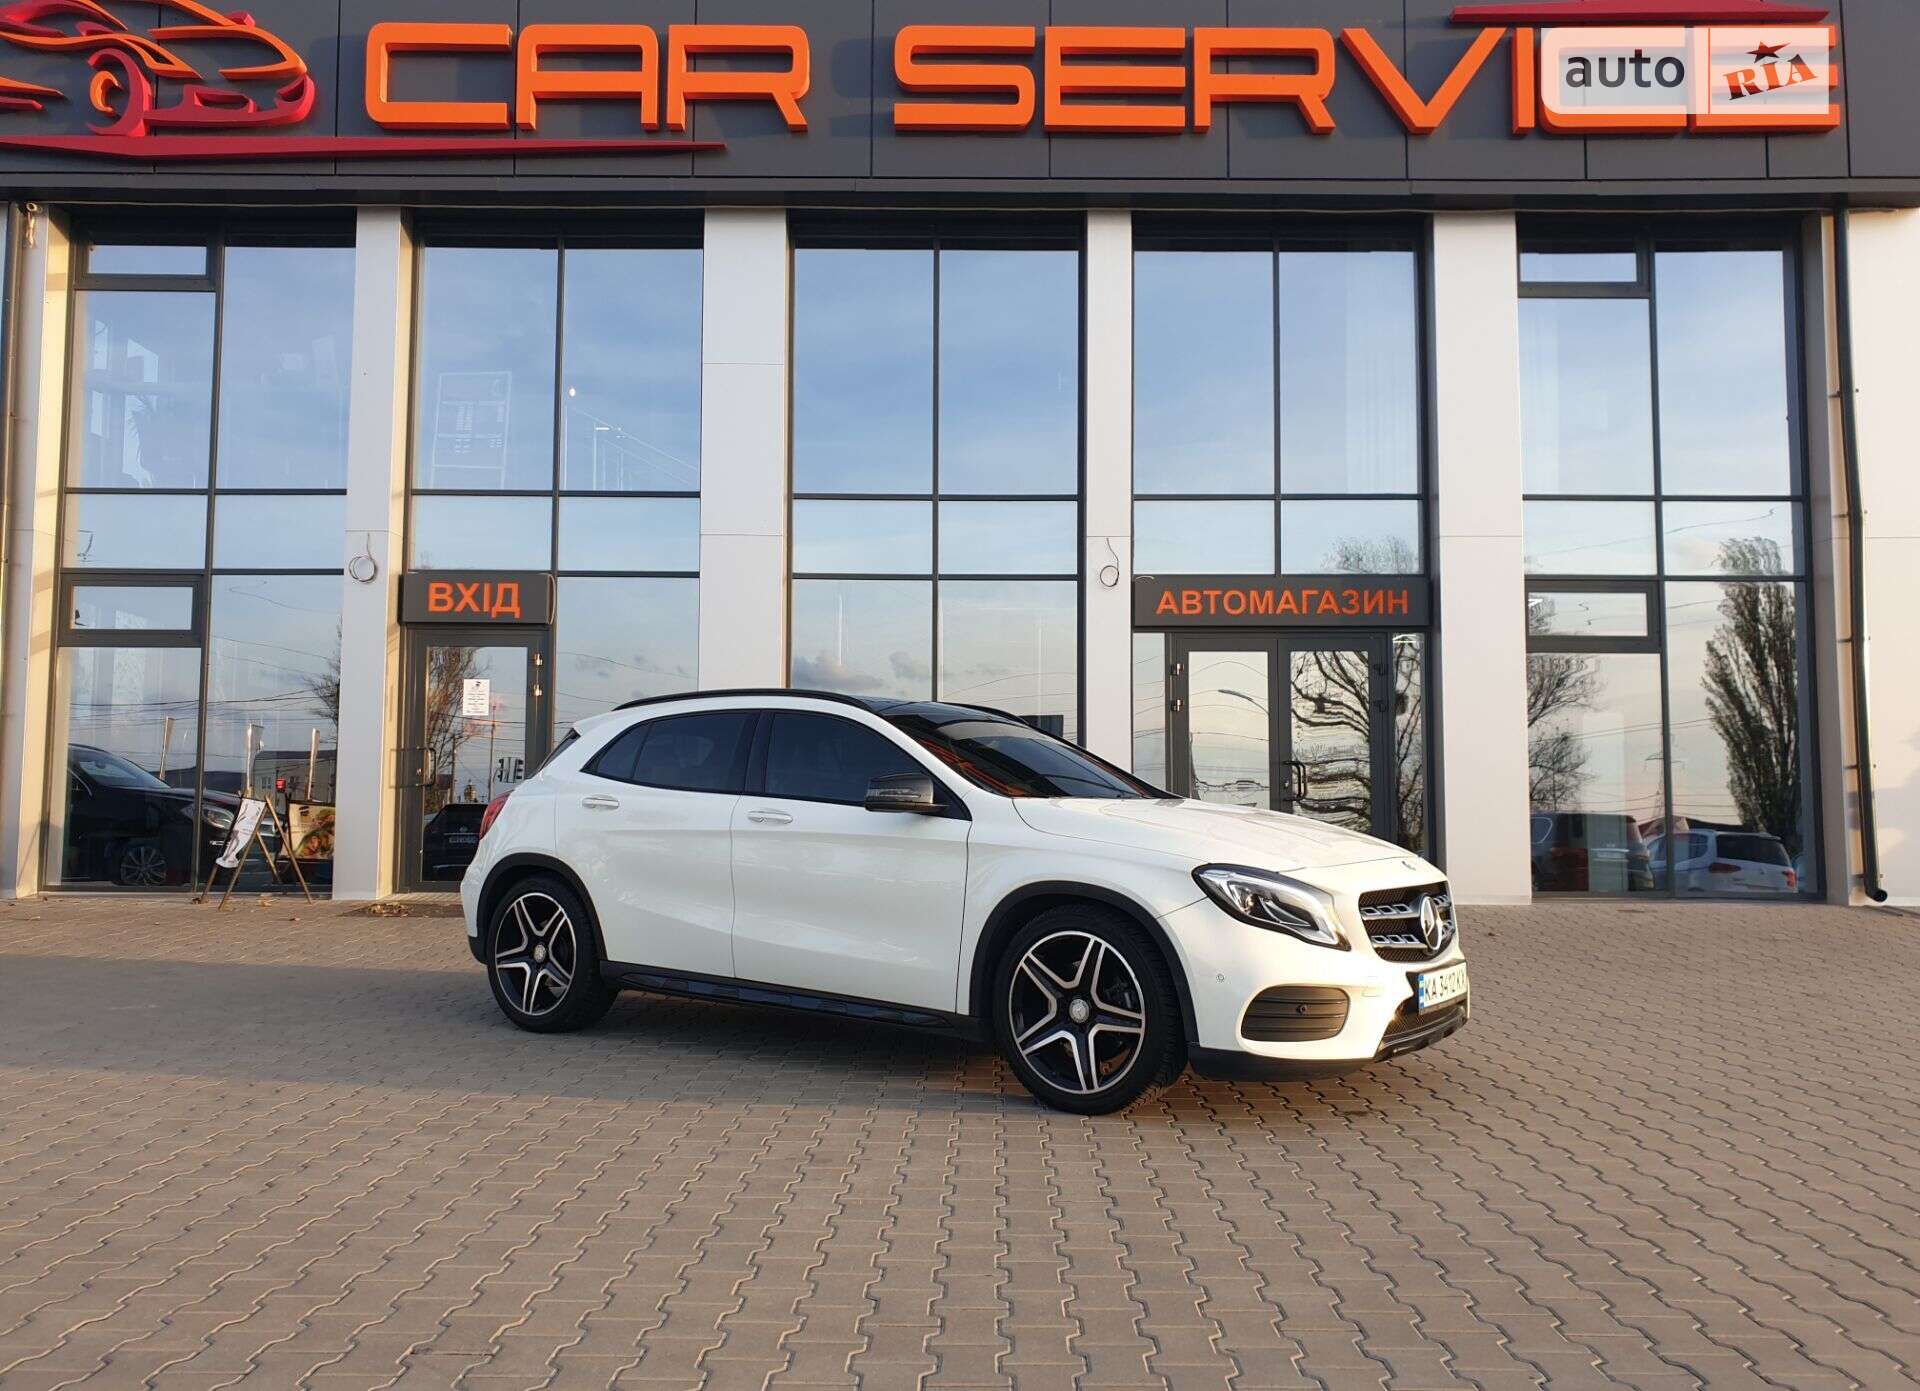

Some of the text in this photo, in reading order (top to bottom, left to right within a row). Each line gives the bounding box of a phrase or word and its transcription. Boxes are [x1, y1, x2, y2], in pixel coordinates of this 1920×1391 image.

[366, 23, 1841, 134] CAR SERVICE
[427, 582, 521, 619] ВХІД
[1156, 590, 1409, 615] АВТОМАГАЗИН
